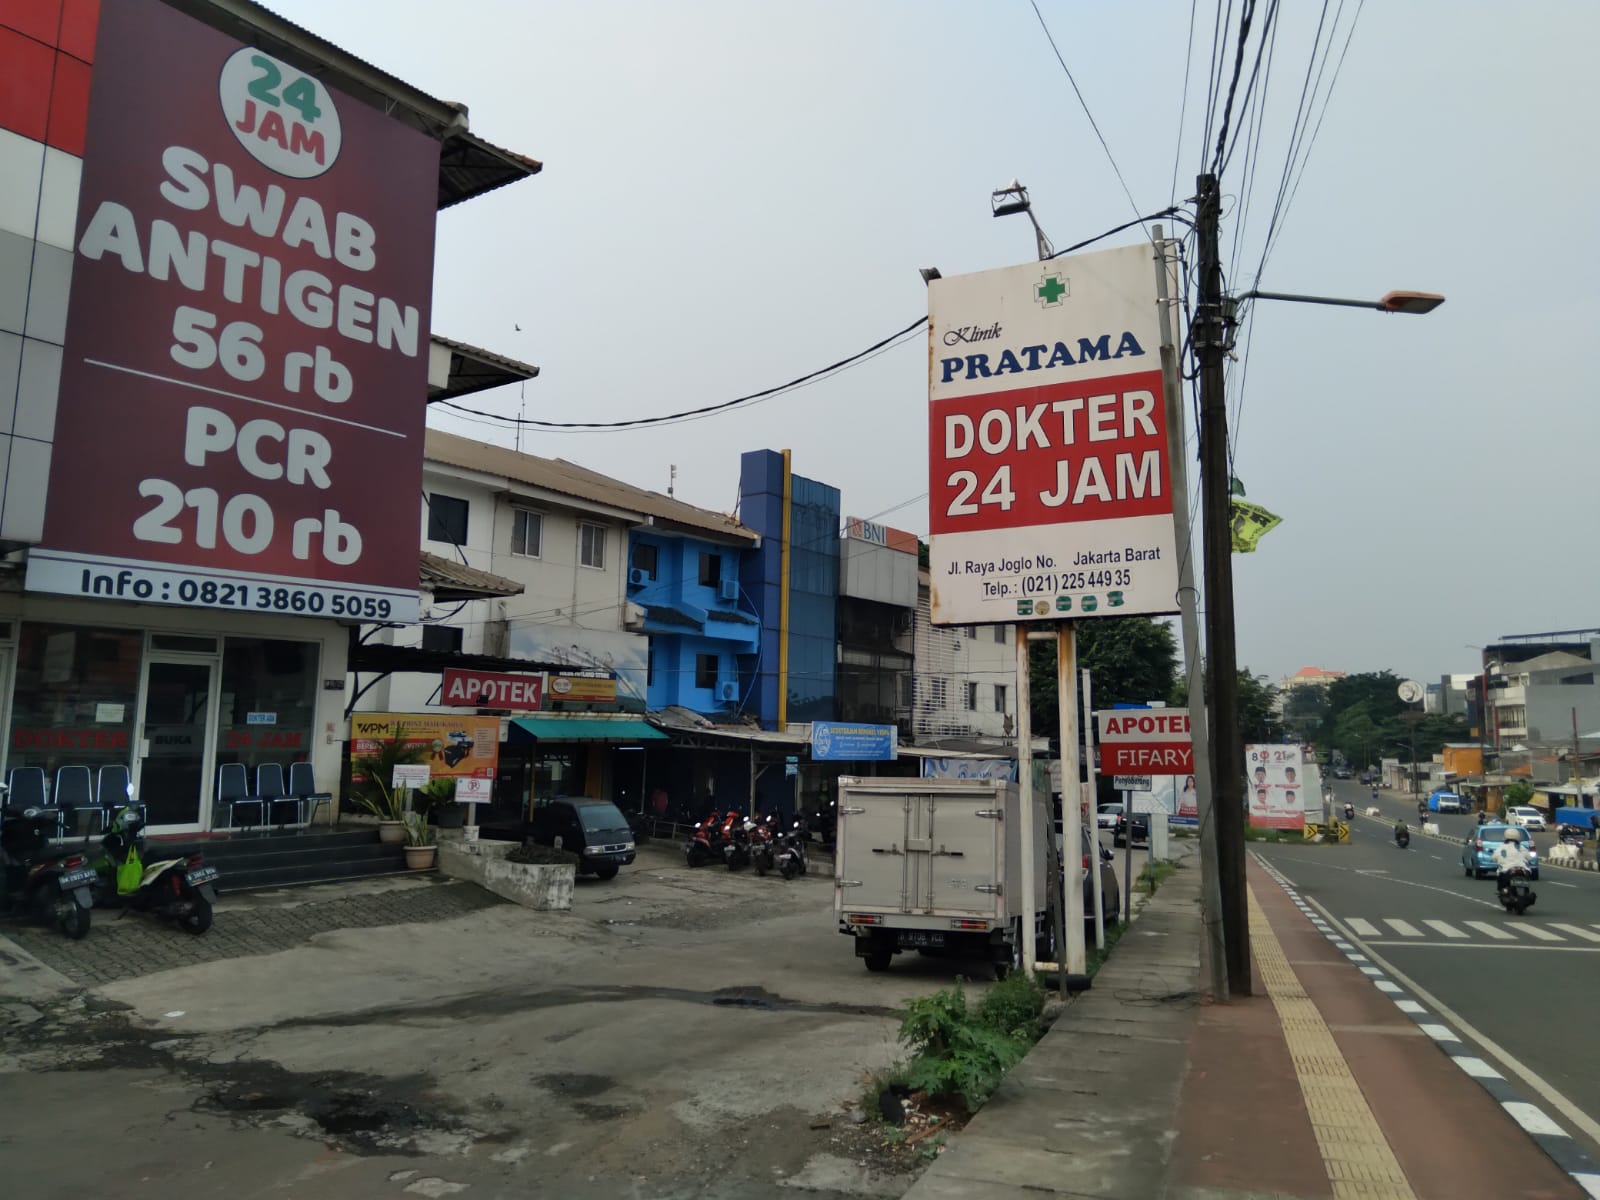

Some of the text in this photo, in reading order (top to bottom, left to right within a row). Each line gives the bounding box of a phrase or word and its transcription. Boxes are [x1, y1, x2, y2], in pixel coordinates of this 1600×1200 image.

[247, 55, 321, 124] 24
[235, 98, 325, 166] JAM
[160, 146, 376, 272] SWAB
[79, 201, 419, 357] ANTIGEN
[170, 306, 353, 403] 56 rb
[943, 321, 1002, 346] Klinik
[940, 331, 1146, 383] PRATAMA
[944, 389, 1158, 460] DOKTER
[184, 406, 332, 489] PCR
[945, 449, 1161, 517] 24 JAM
[133, 478, 362, 566] 210 rb
[864, 521, 885, 545] BNI
[947, 546, 1160, 577] Jl. Raya Joglo No. Jakarta Barat
[178, 579, 248, 606] 0821
[256, 586, 325, 613] 3860
[331, 594, 391, 618] 5059
[1021, 574, 1059, 596] (021)
[448, 677, 538, 704] APOTEK
[14, 729, 129, 749] DOKTER
[155, 735, 192, 745] BUKA
[225, 731, 303, 749] 24 JAM
[1117, 748, 1192, 766] FIFARY
